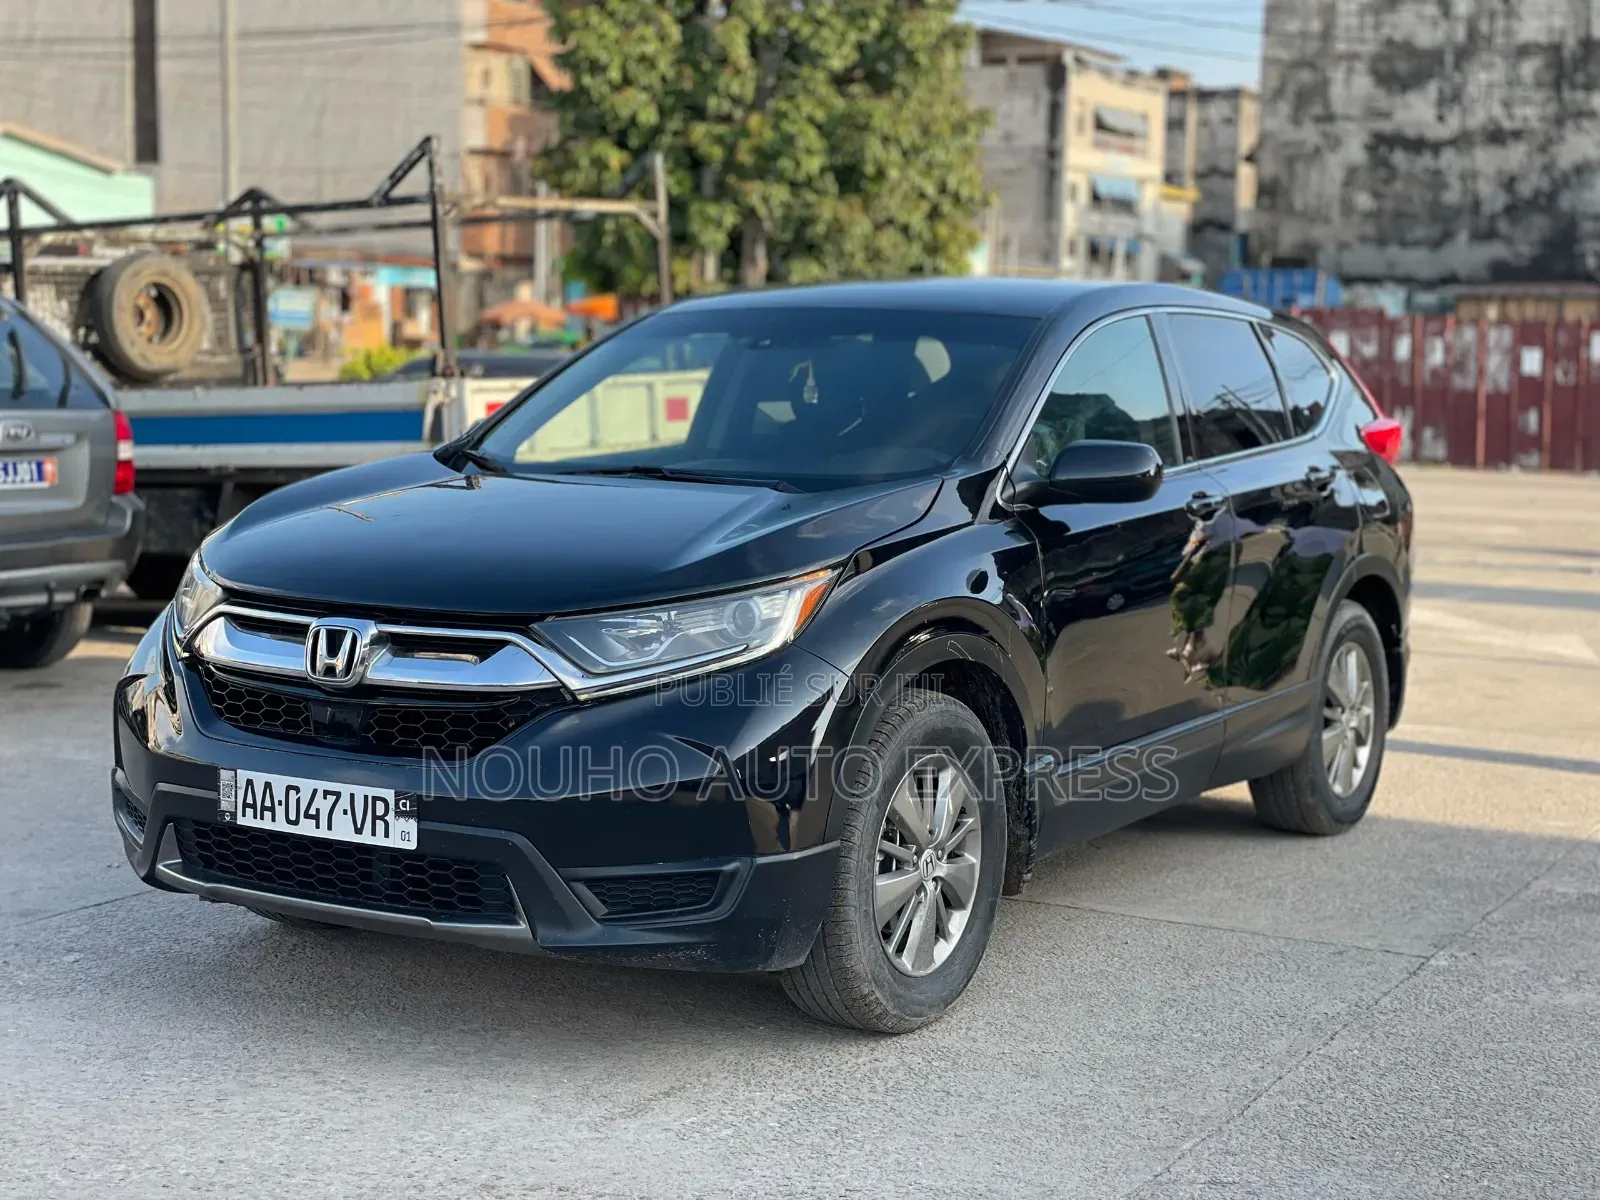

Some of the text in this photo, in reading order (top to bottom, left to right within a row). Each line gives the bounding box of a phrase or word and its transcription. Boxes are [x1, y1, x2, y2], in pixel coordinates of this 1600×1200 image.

[241, 778, 390, 838] AA-047-VR
[399, 799, 410, 811] CI
[400, 830, 411, 842] 01
